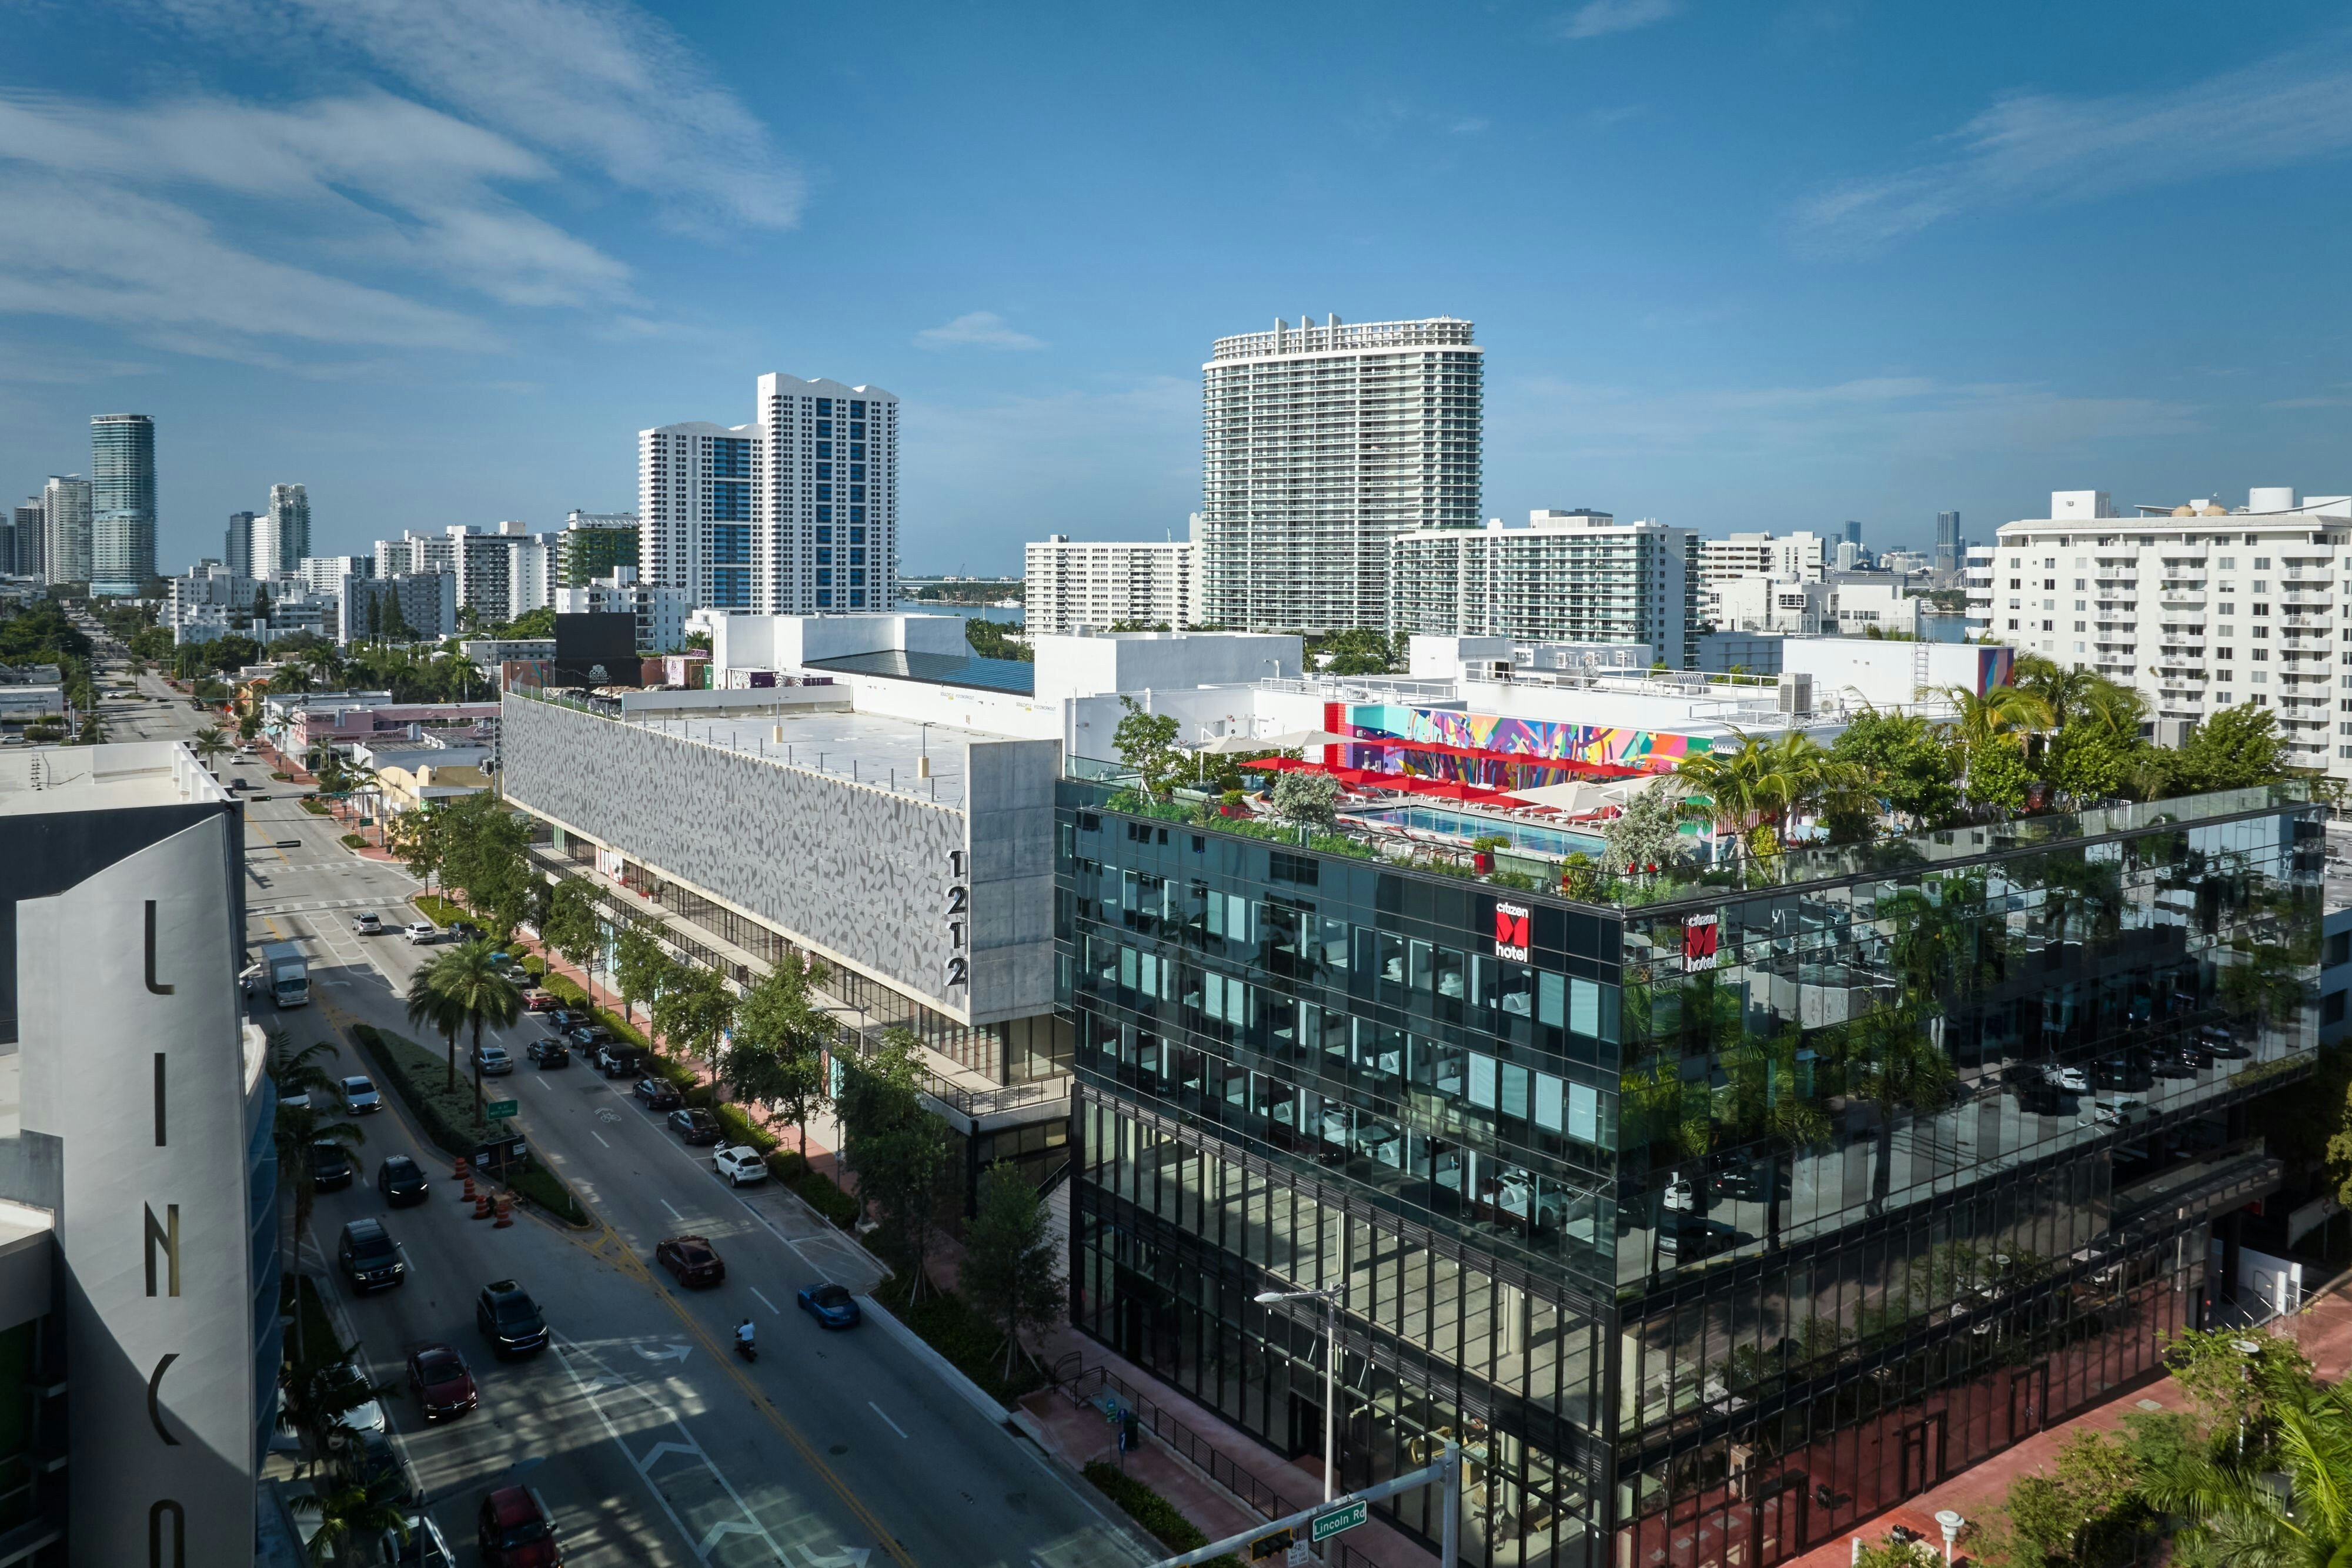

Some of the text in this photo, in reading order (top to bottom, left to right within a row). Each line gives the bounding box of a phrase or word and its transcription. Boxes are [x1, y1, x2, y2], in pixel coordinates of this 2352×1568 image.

[944, 850, 966, 987] 1212
[1496, 902, 1529, 918] citizen
[1688, 914, 1717, 927] citizen
[1496, 941, 1528, 962] hotel
[1687, 952, 1716, 972] hotel
[1315, 1507, 1365, 1536] Lincoln Rd
